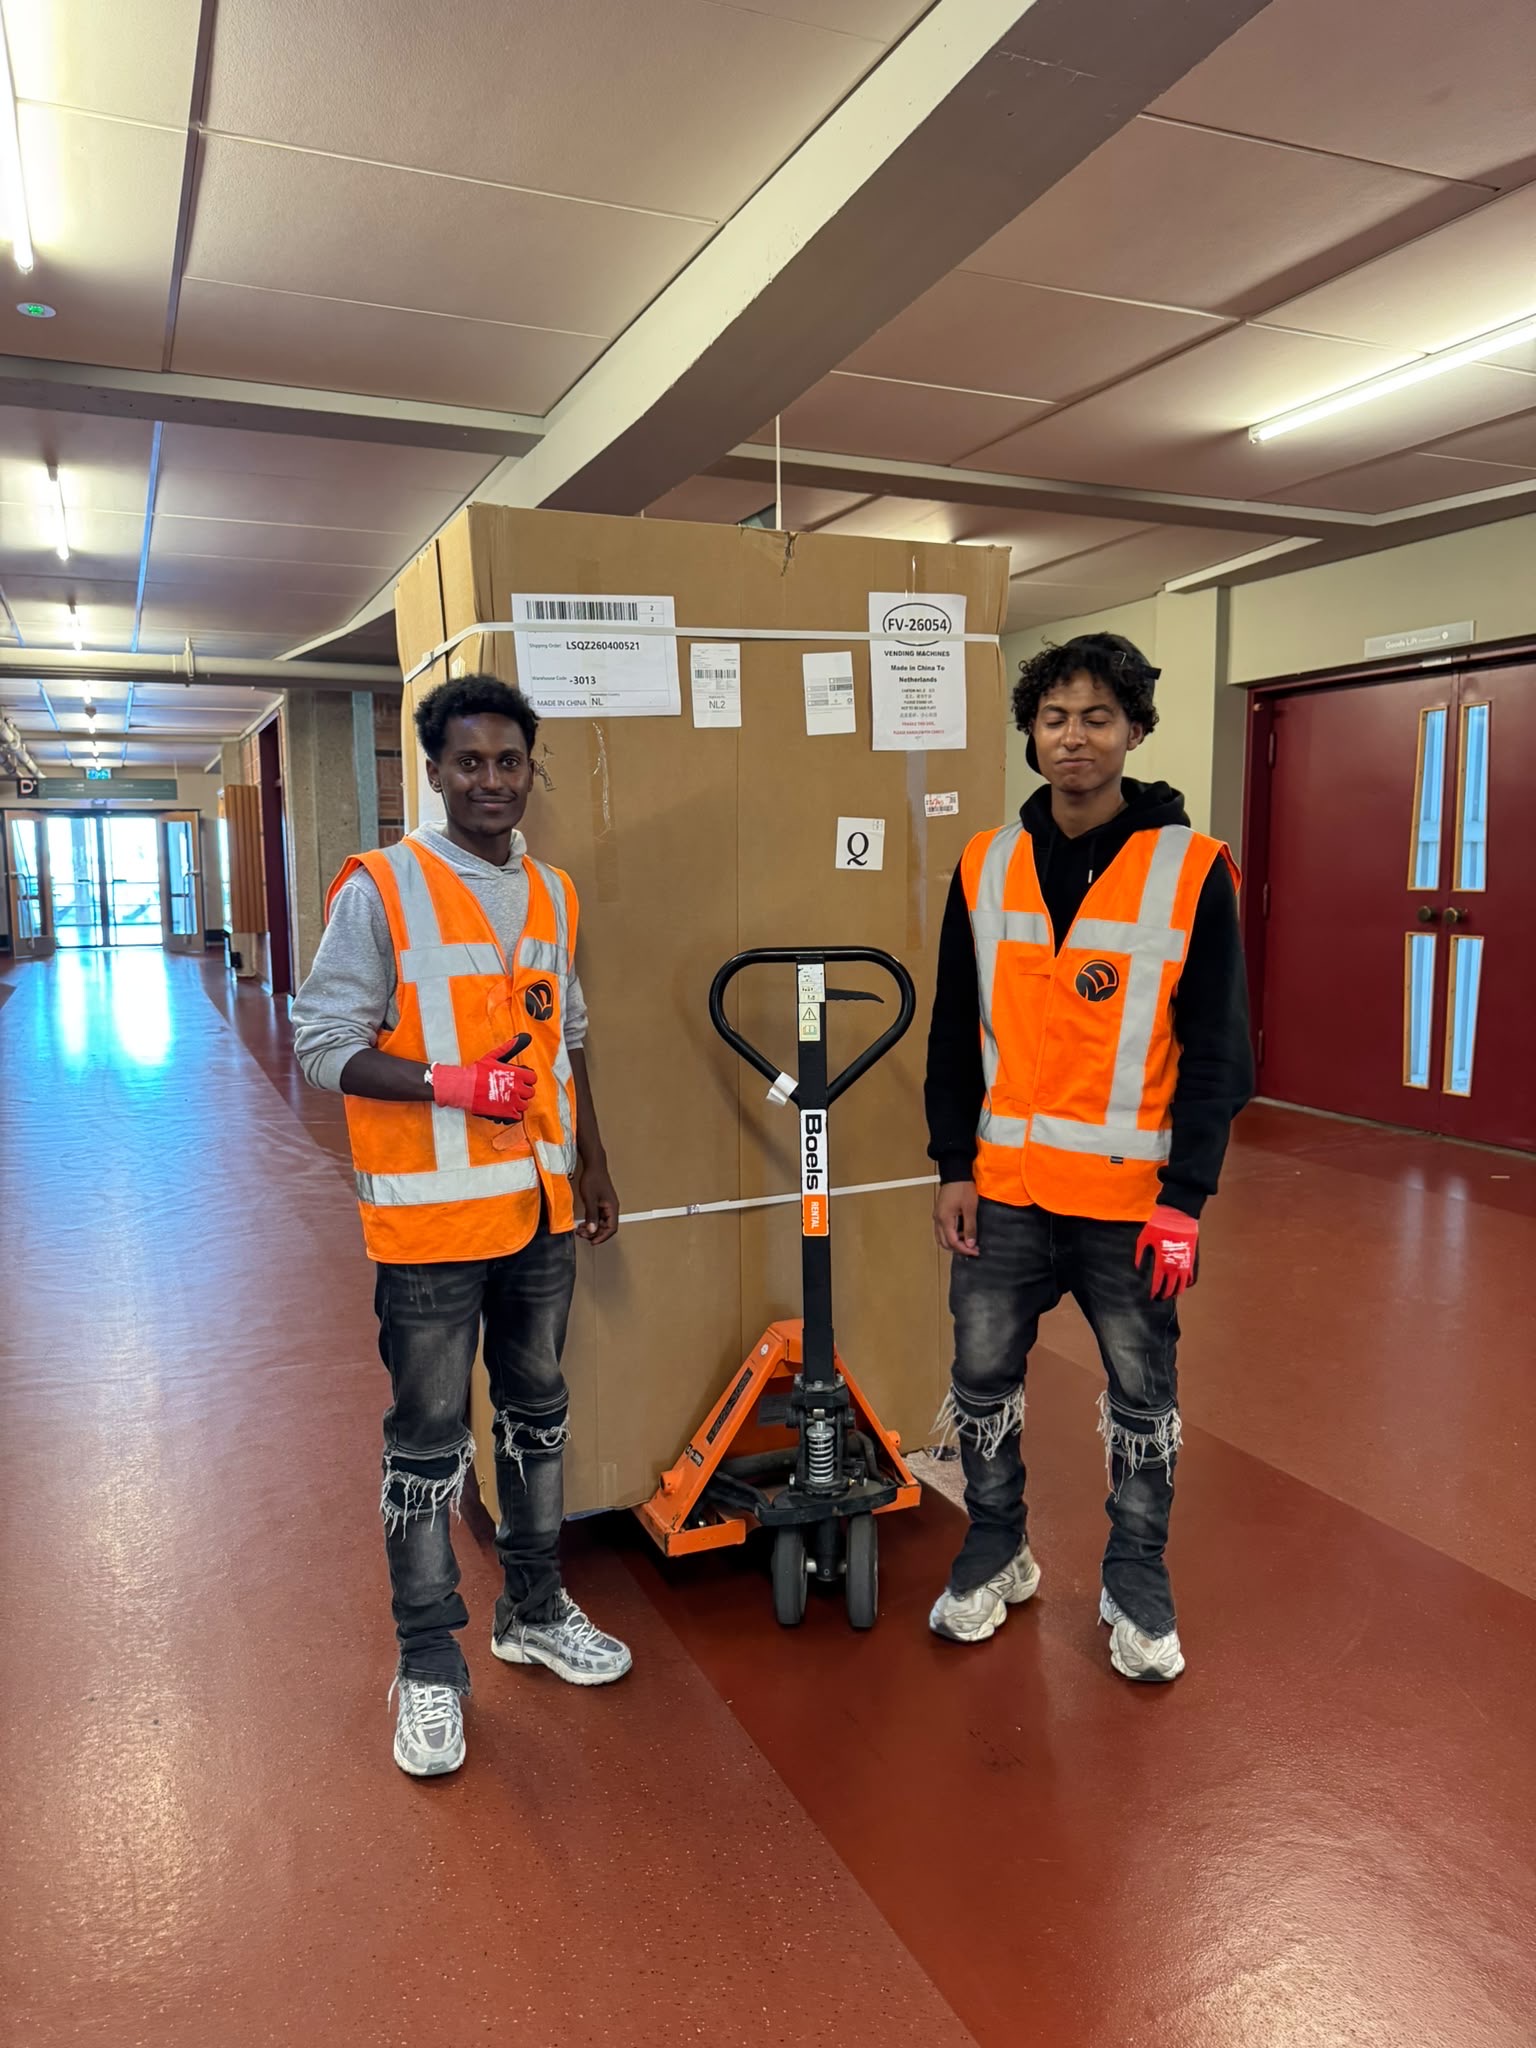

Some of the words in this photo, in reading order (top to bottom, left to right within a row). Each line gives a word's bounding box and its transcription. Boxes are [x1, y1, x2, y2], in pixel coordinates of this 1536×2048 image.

[888, 618, 947, 631] FV-26054
[566, 641, 640, 650] LSQZ260400521
[569, 676, 597, 685] -3013
[591, 697, 603, 706] NL
[709, 700, 726, 709] NL2
[847, 832, 869, 866] Q
[805, 1114, 823, 1190] Boels
[811, 1201, 820, 1229] RENTAL
